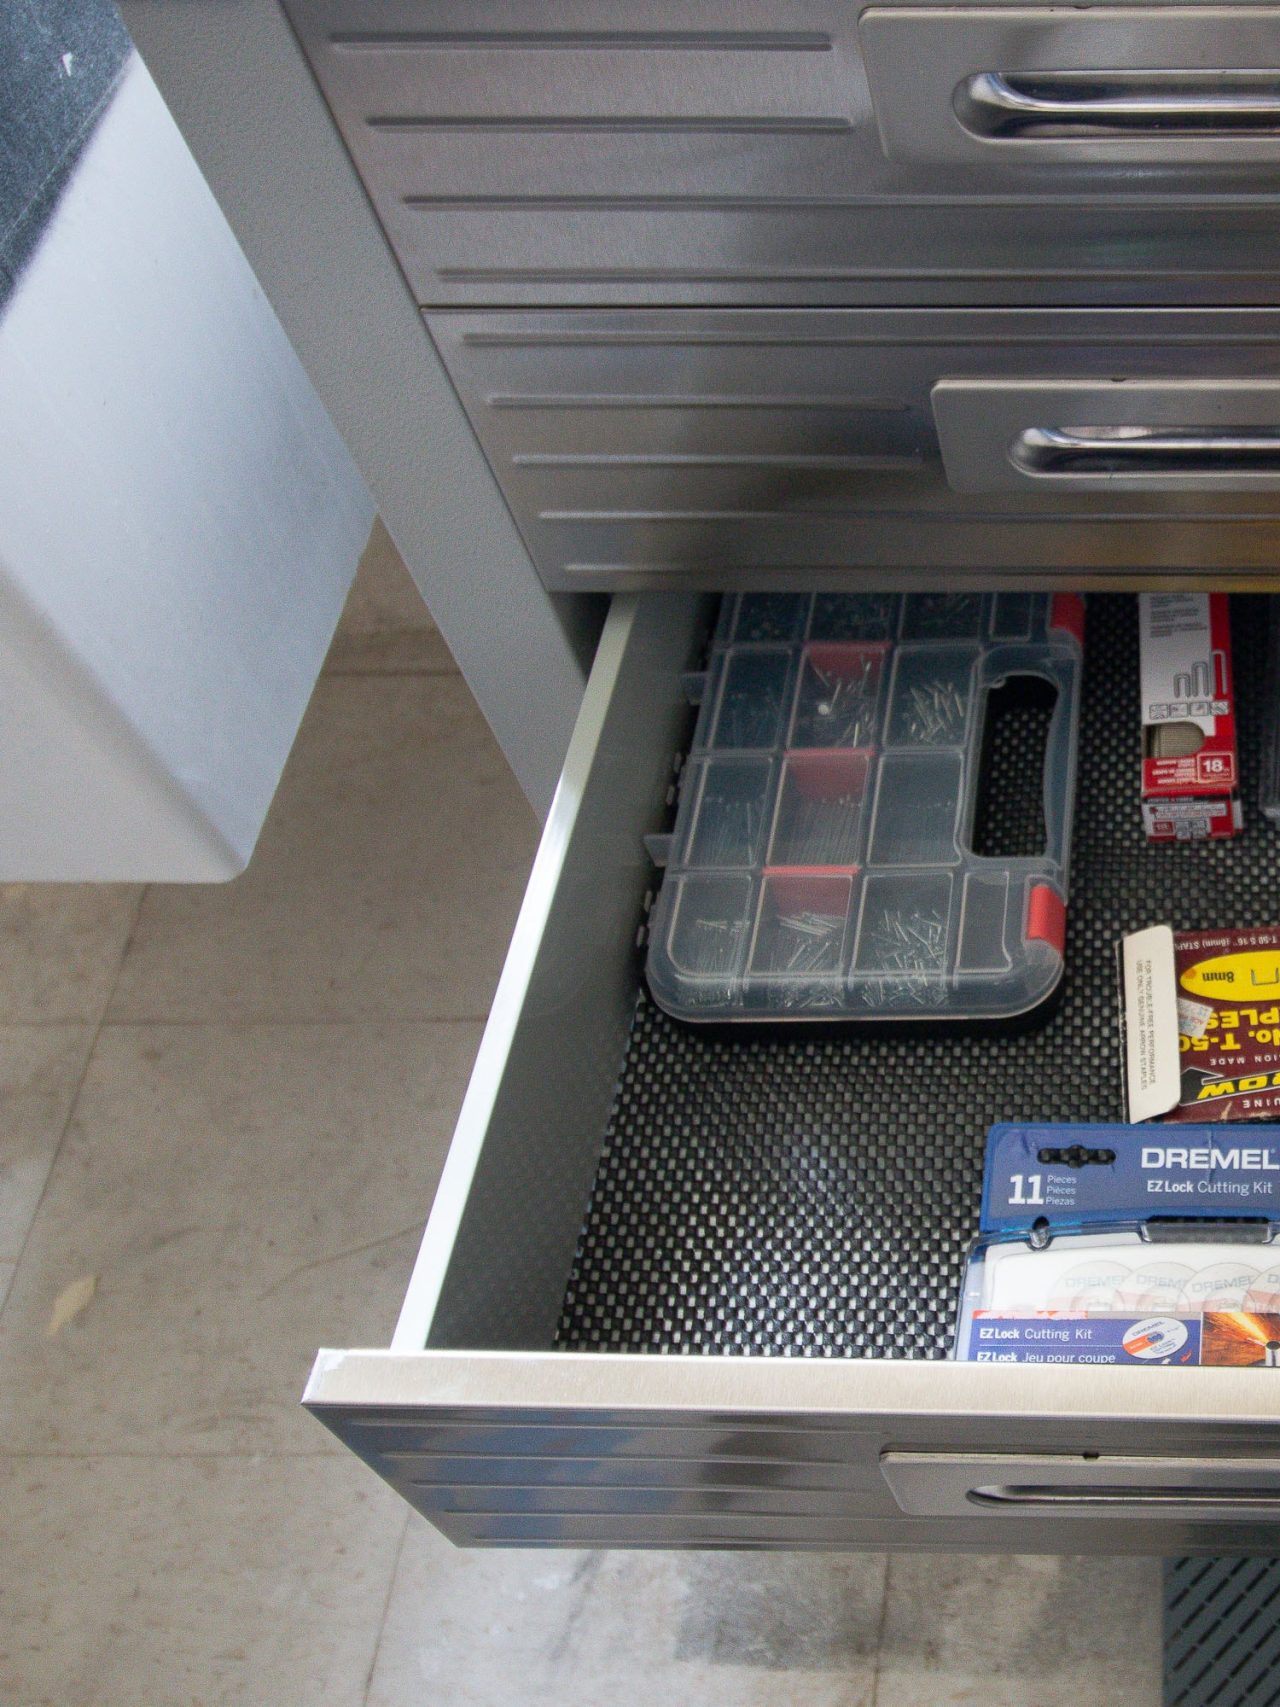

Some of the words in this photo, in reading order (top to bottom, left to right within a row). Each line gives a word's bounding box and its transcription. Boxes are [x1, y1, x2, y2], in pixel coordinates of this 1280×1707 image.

[1203, 760, 1223, 773] 18
[1202, 972, 1235, 982] 8mm
[1210, 1056, 1246, 1066] MADE
[1141, 1148, 1280, 1170] DREMEL
[1047, 1175, 1077, 1184] Pieces
[1008, 1174, 1044, 1204] 11
[1165, 1180, 1194, 1192] Lock
[1197, 1180, 1250, 1196] Cutting
[1253, 1181, 1272, 1194] Kit
[1046, 1196, 1076, 1206] Piezas
[1066, 1275, 1123, 1288] DREME
[996, 1328, 1020, 1339] Lock
[1024, 1328, 1070, 1342] Cutting
[1075, 1328, 1093, 1340] Kit
[1022, 1352, 1044, 1362] Jeu
